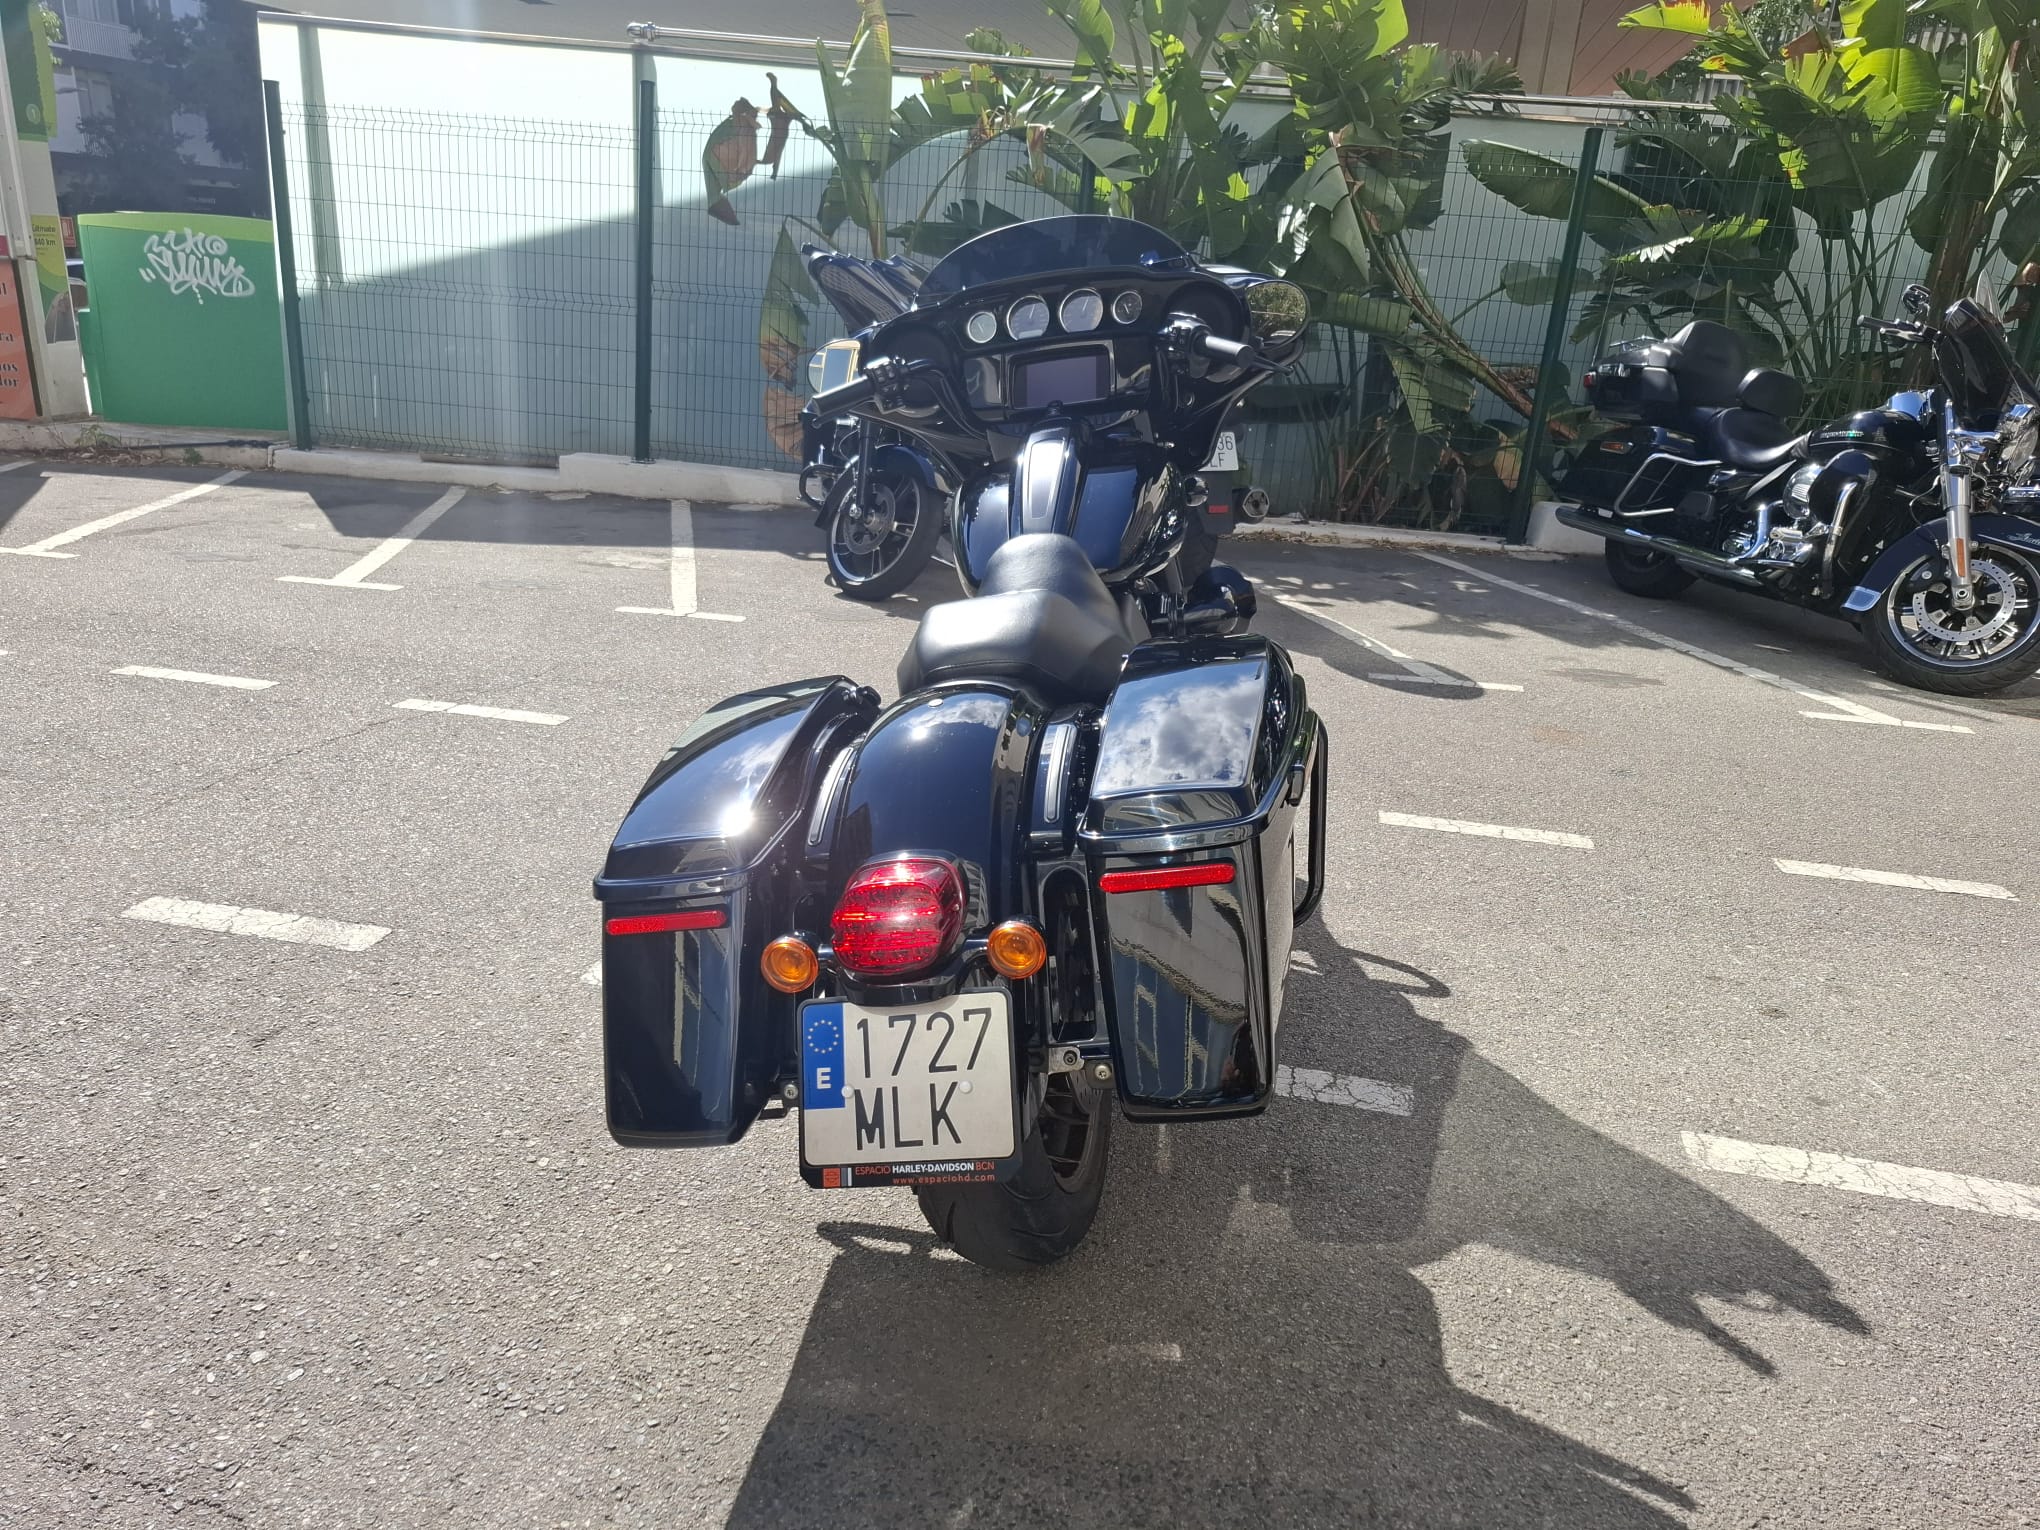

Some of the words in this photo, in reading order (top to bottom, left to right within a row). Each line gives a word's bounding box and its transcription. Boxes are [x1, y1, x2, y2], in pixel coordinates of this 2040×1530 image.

[856, 1007, 992, 1078] 1727
[816, 1067, 831, 1089] E
[854, 1081, 962, 1151] MLK
[855, 1165, 891, 1175] ESPACIO
[892, 1162, 975, 1174] HARLEY-DAVIDSON
[975, 1161, 995, 1171] BCN
[892, 1173, 996, 1184] www.espaciohd.com
